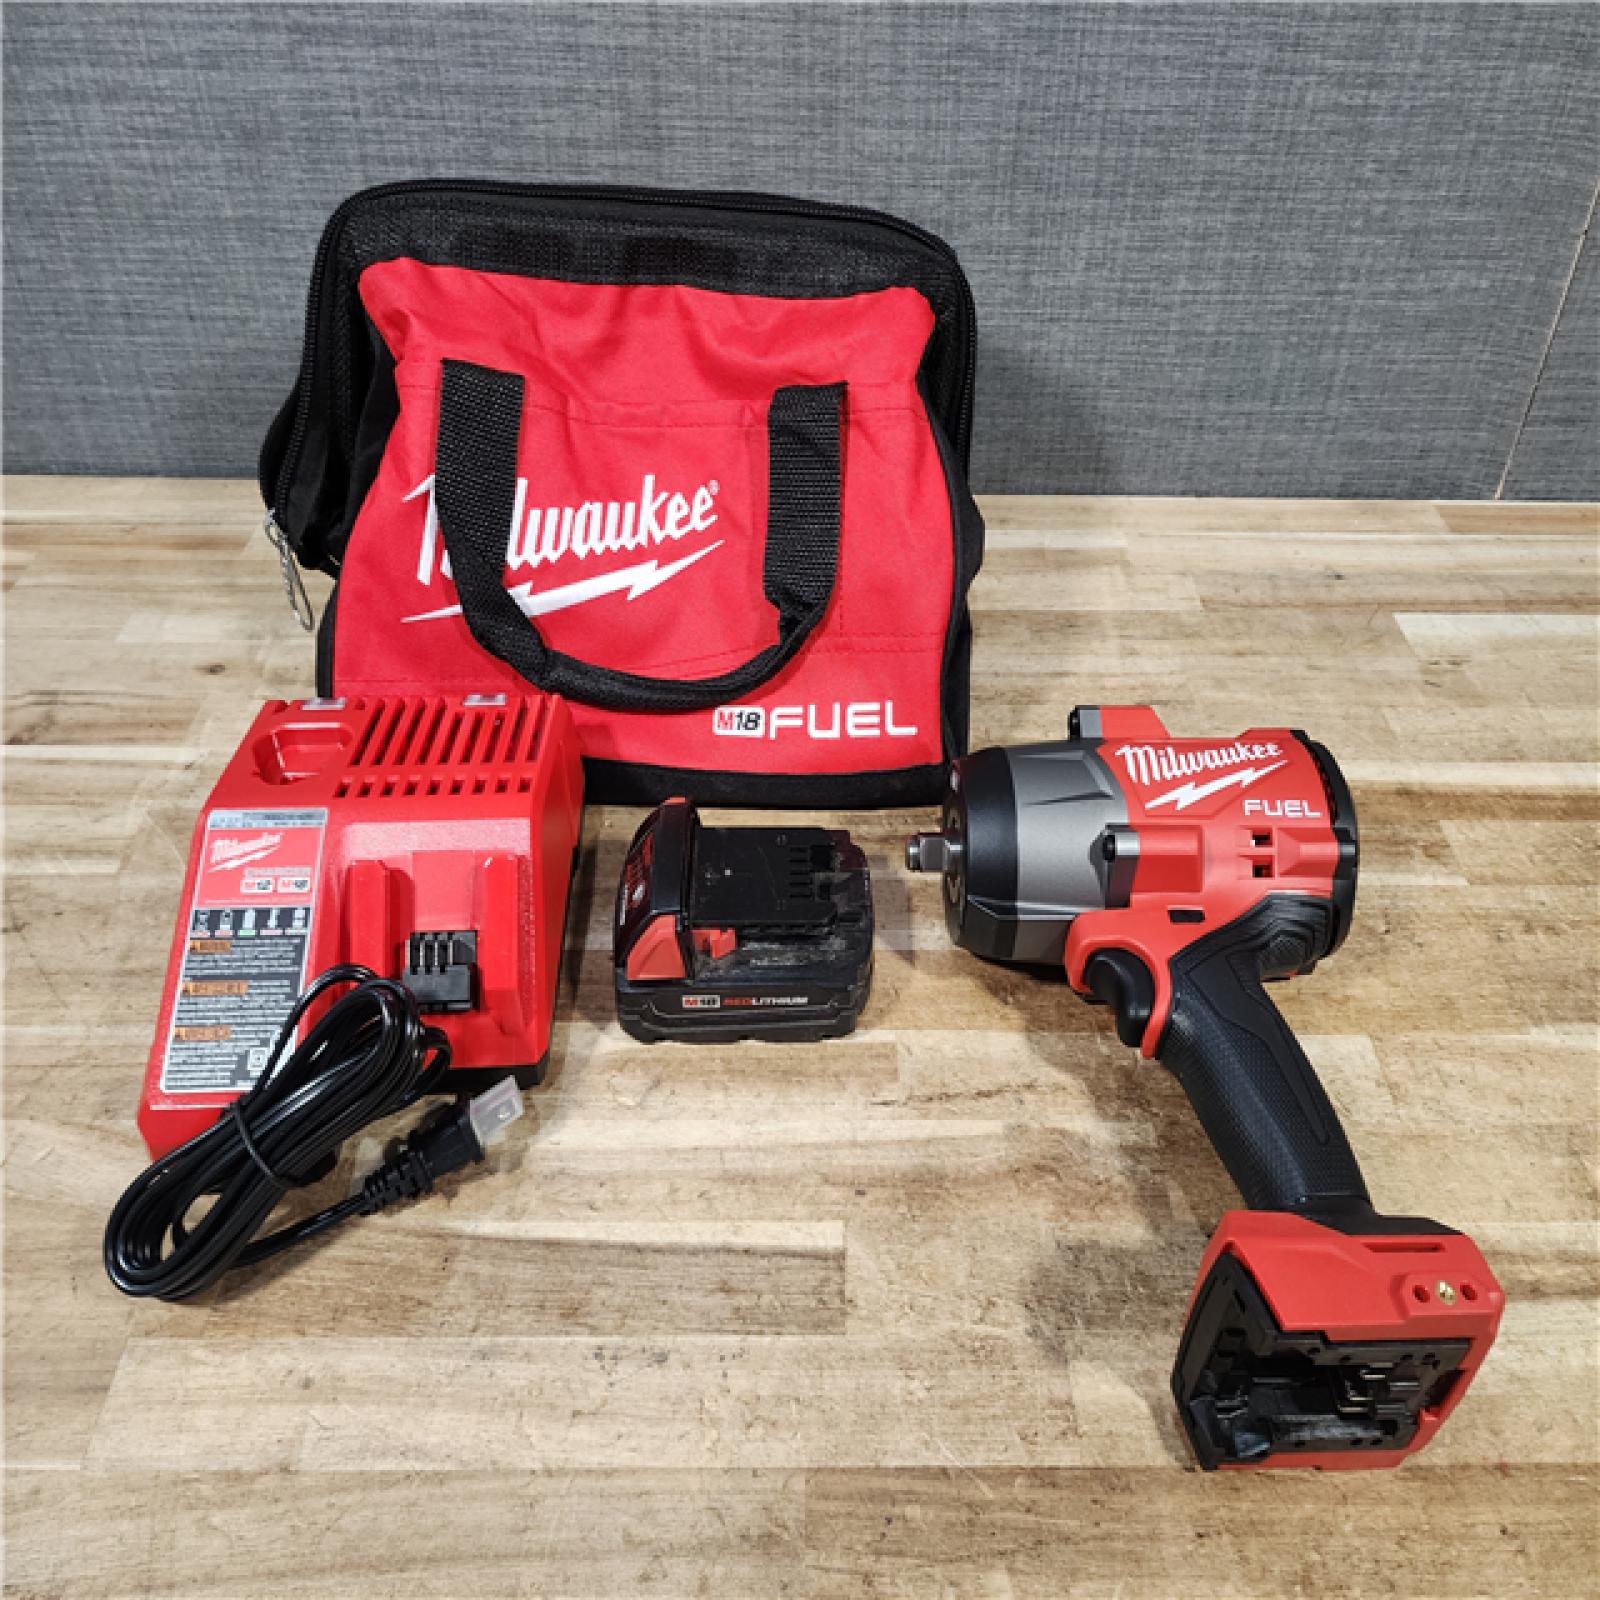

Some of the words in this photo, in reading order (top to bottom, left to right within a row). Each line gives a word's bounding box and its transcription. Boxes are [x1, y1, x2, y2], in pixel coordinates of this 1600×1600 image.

[402, 474, 717, 585] lwaukee
[715, 707, 763, 733] M18
[769, 701, 918, 739] FUEL
[1115, 742, 1283, 785] Milwaukee
[1244, 799, 1321, 817] FUEL
